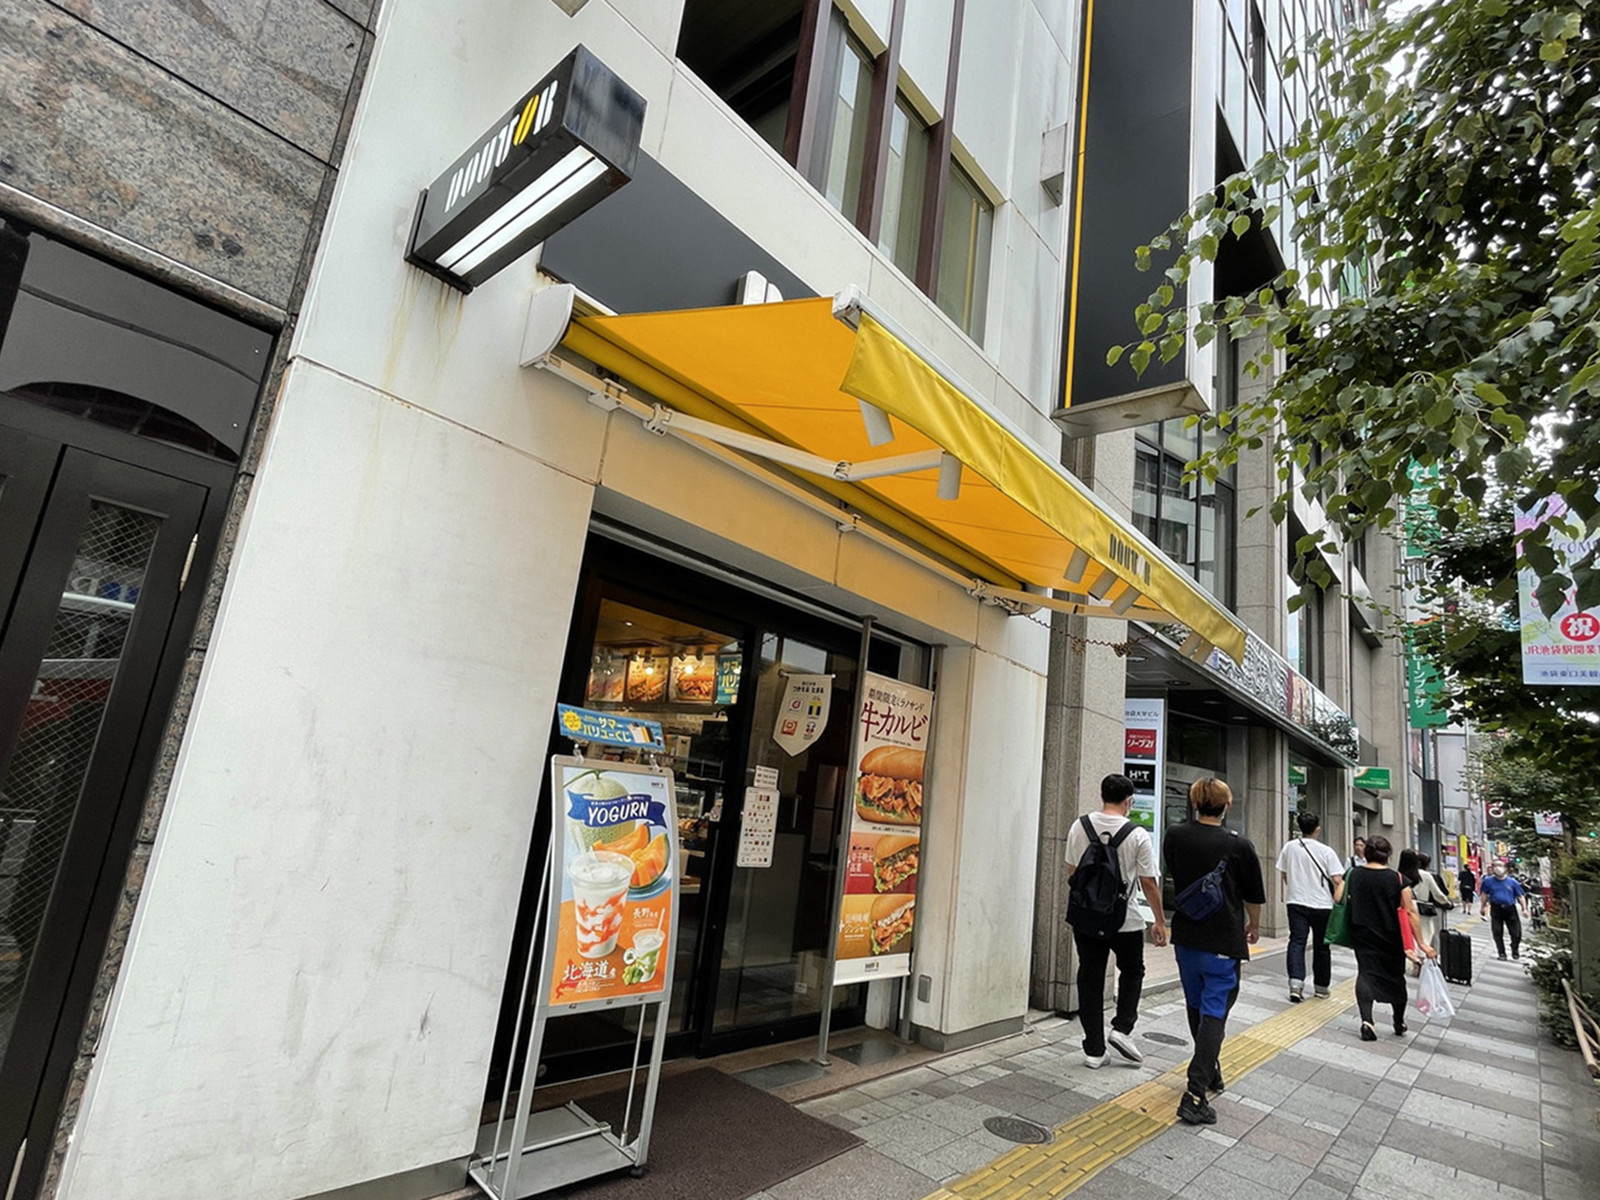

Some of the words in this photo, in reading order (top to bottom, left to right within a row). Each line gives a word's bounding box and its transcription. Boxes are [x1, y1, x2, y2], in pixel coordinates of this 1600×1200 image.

[444, 79, 558, 213] DOUTOR
[1567, 616, 1595, 637] 祝
[598, 716, 623, 729] サマー
[860, 700, 929, 742] 牛カルビ
[588, 801, 649, 825] YOGURN
